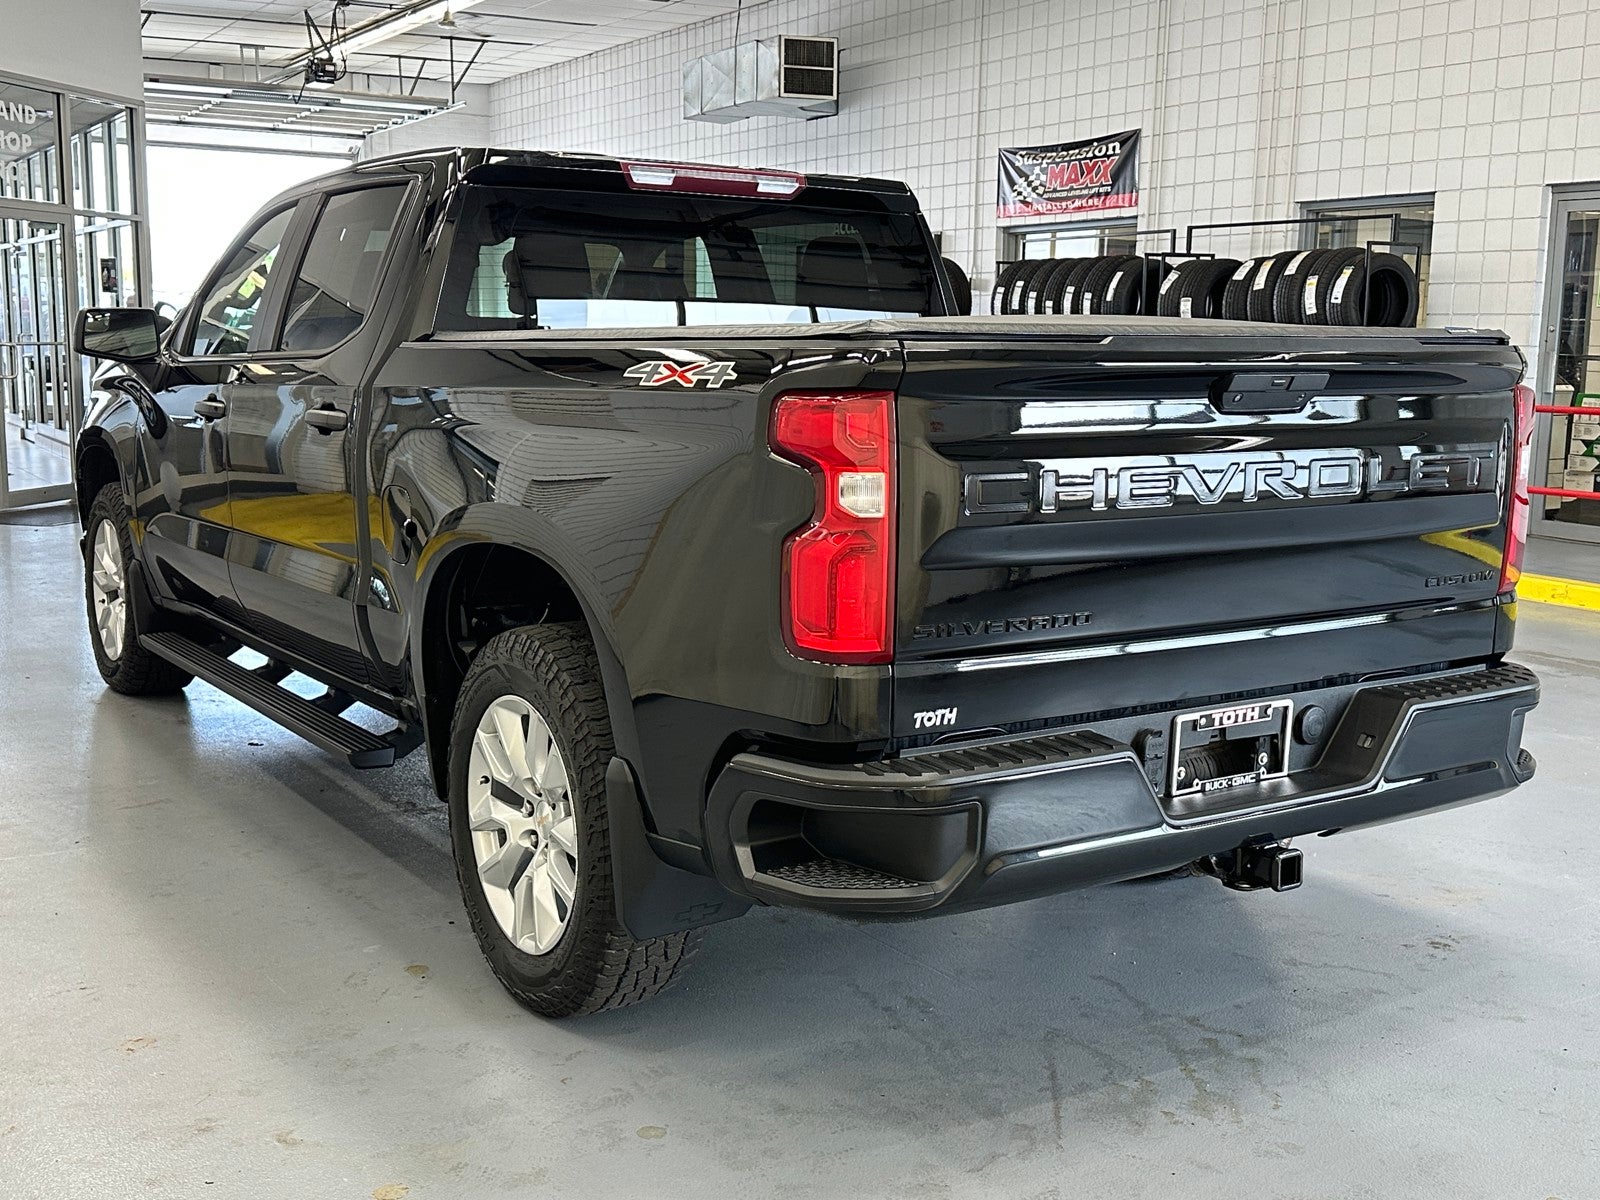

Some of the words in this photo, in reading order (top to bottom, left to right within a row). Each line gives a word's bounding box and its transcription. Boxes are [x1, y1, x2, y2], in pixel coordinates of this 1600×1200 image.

[1015, 141, 1121, 168] Suspension
[1045, 155, 1119, 191] MAXX
[964, 447, 1494, 517] CHEVROLET
[1424, 569, 1495, 588] CUSTOM
[912, 610, 1094, 641] SILVERADO
[913, 706, 958, 729] TOTH
[1211, 705, 1260, 727] TOTH
